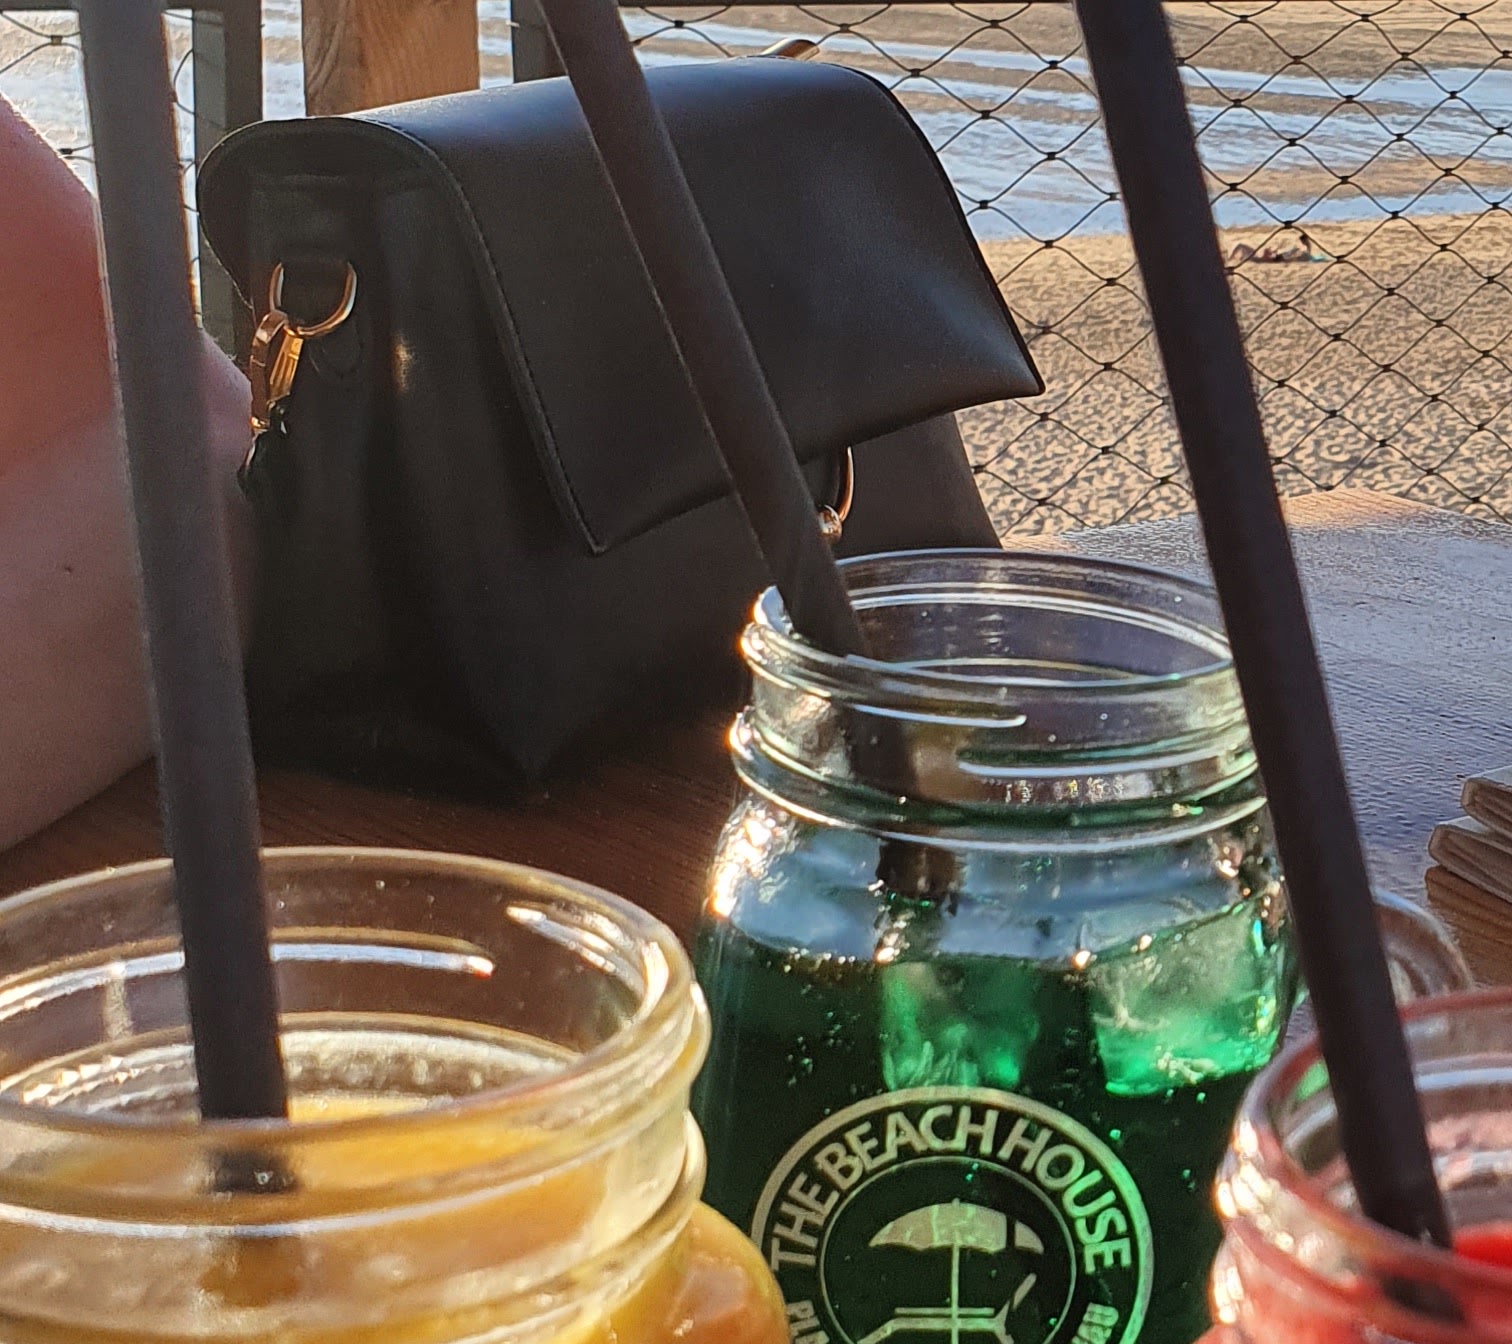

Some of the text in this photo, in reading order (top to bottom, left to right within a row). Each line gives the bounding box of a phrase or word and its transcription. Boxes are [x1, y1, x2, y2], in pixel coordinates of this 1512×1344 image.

[772, 1104, 1133, 1274] THE BEACH HOUSE
